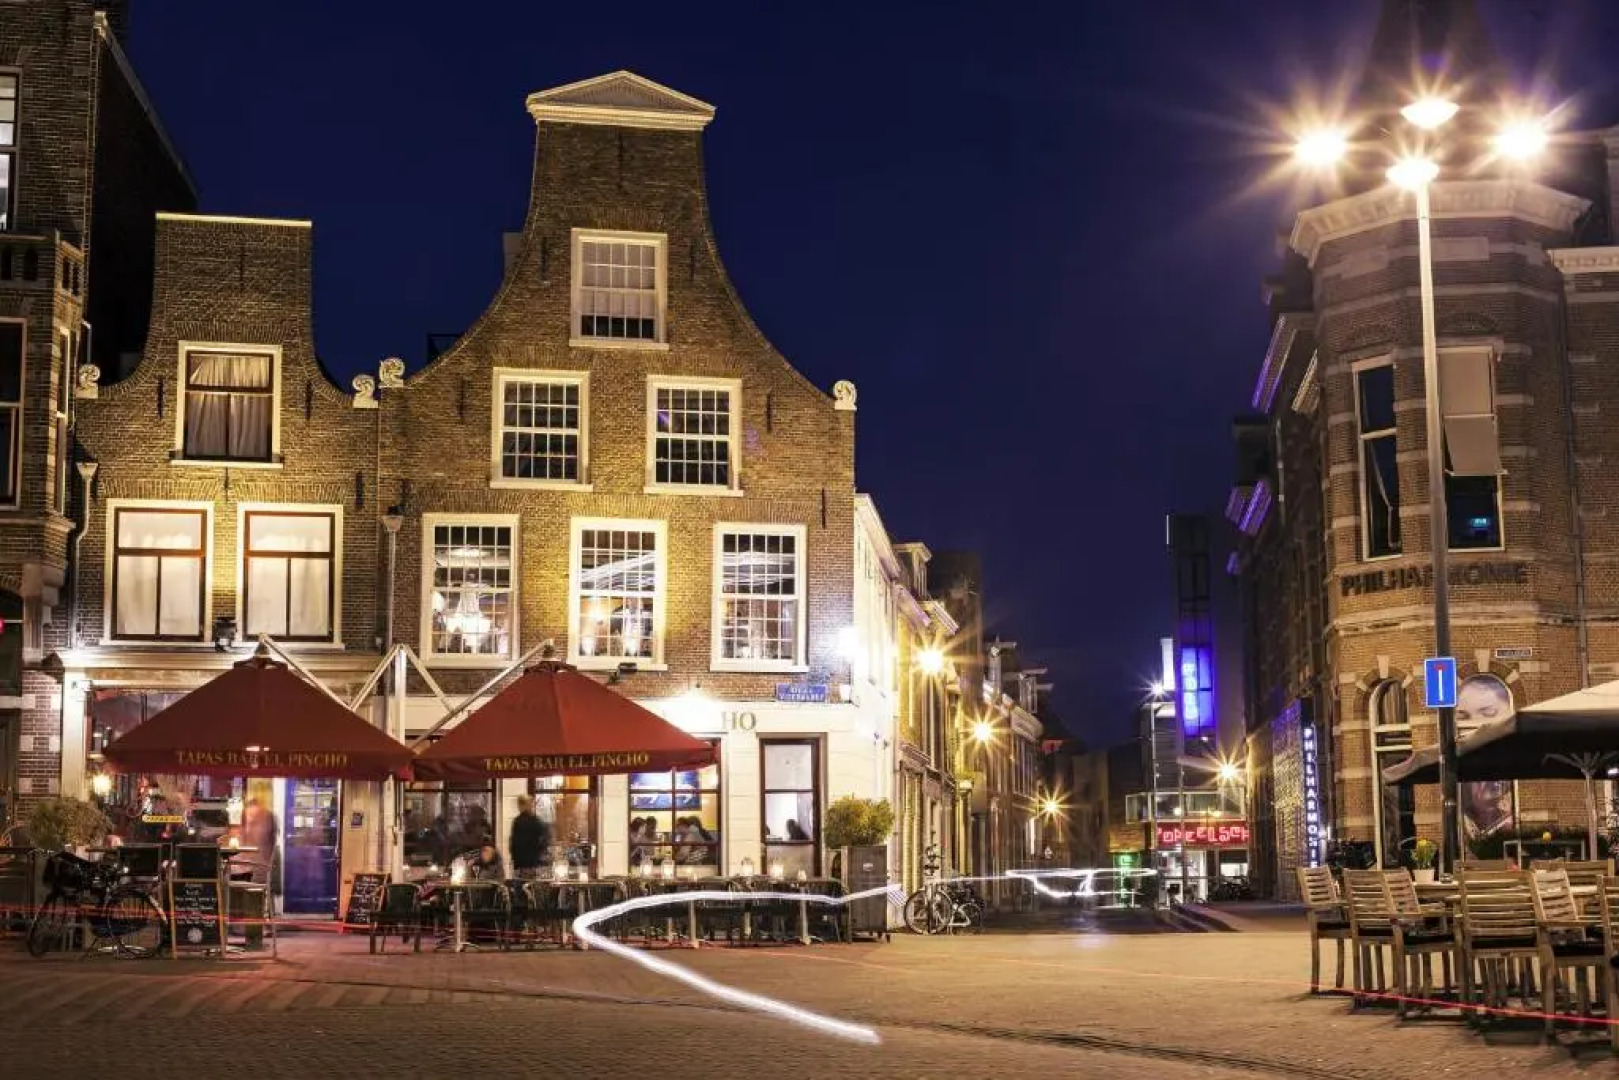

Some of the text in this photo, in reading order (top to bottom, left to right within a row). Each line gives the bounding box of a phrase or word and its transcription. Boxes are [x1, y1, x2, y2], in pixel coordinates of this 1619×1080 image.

[177, 751, 222, 766] TAPAS
[264, 752, 284, 766] EL
[288, 752, 349, 768] PINCHO
[484, 751, 650, 771] TAPAS BAR EL PINCHO
